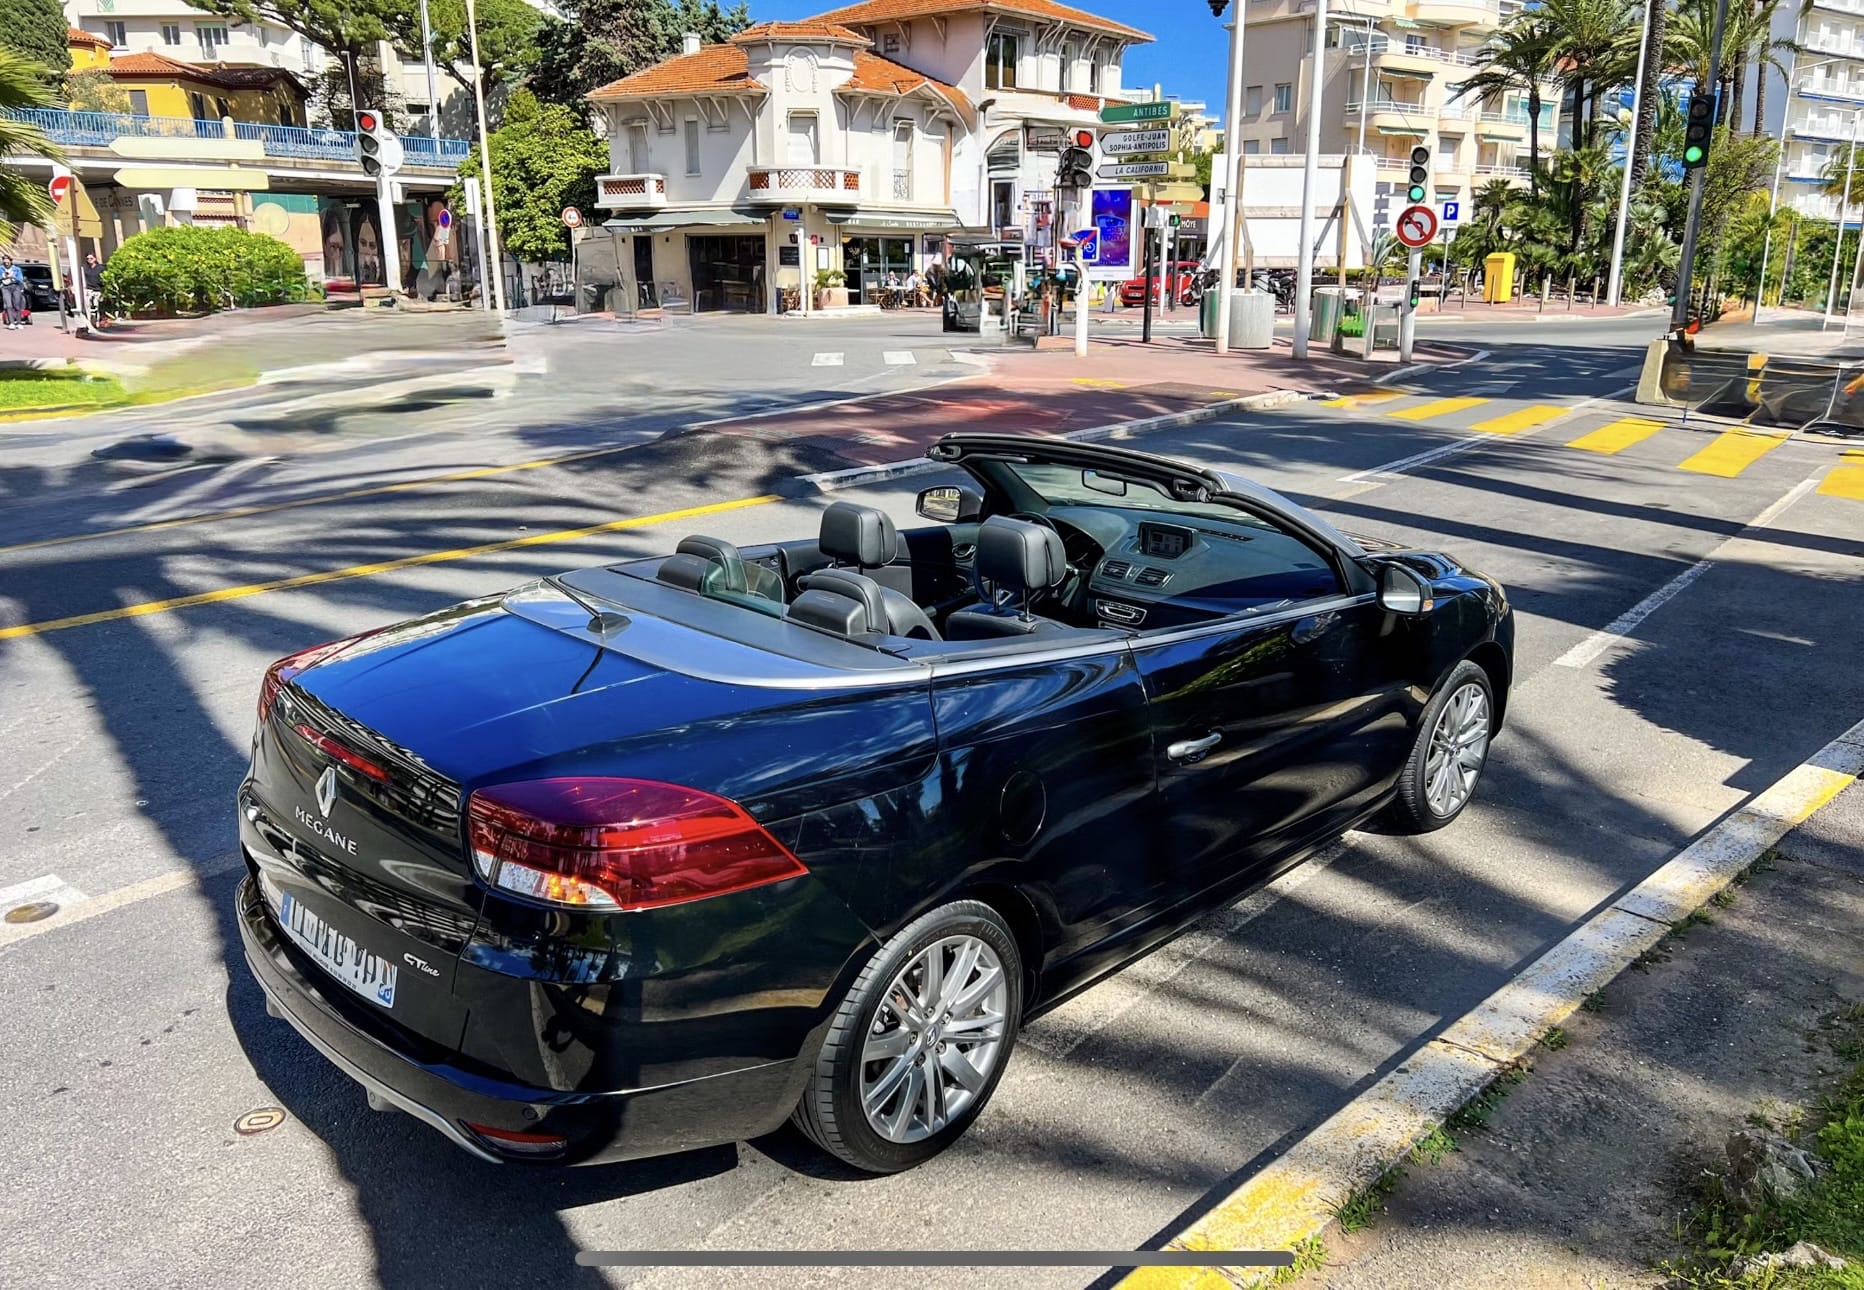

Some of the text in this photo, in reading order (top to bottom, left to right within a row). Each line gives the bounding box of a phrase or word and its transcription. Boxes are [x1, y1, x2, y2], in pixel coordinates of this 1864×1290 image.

[1133, 105, 1168, 117] ANTIBES
[1122, 133, 1167, 143] GOLFE-JUAN
[1109, 141, 1166, 152] SOPHIA-ANTIPOLIS
[1115, 164, 1165, 175] LA CALIFORNIE
[1447, 205, 1455, 218] P
[295, 805, 359, 856] MEGANE
